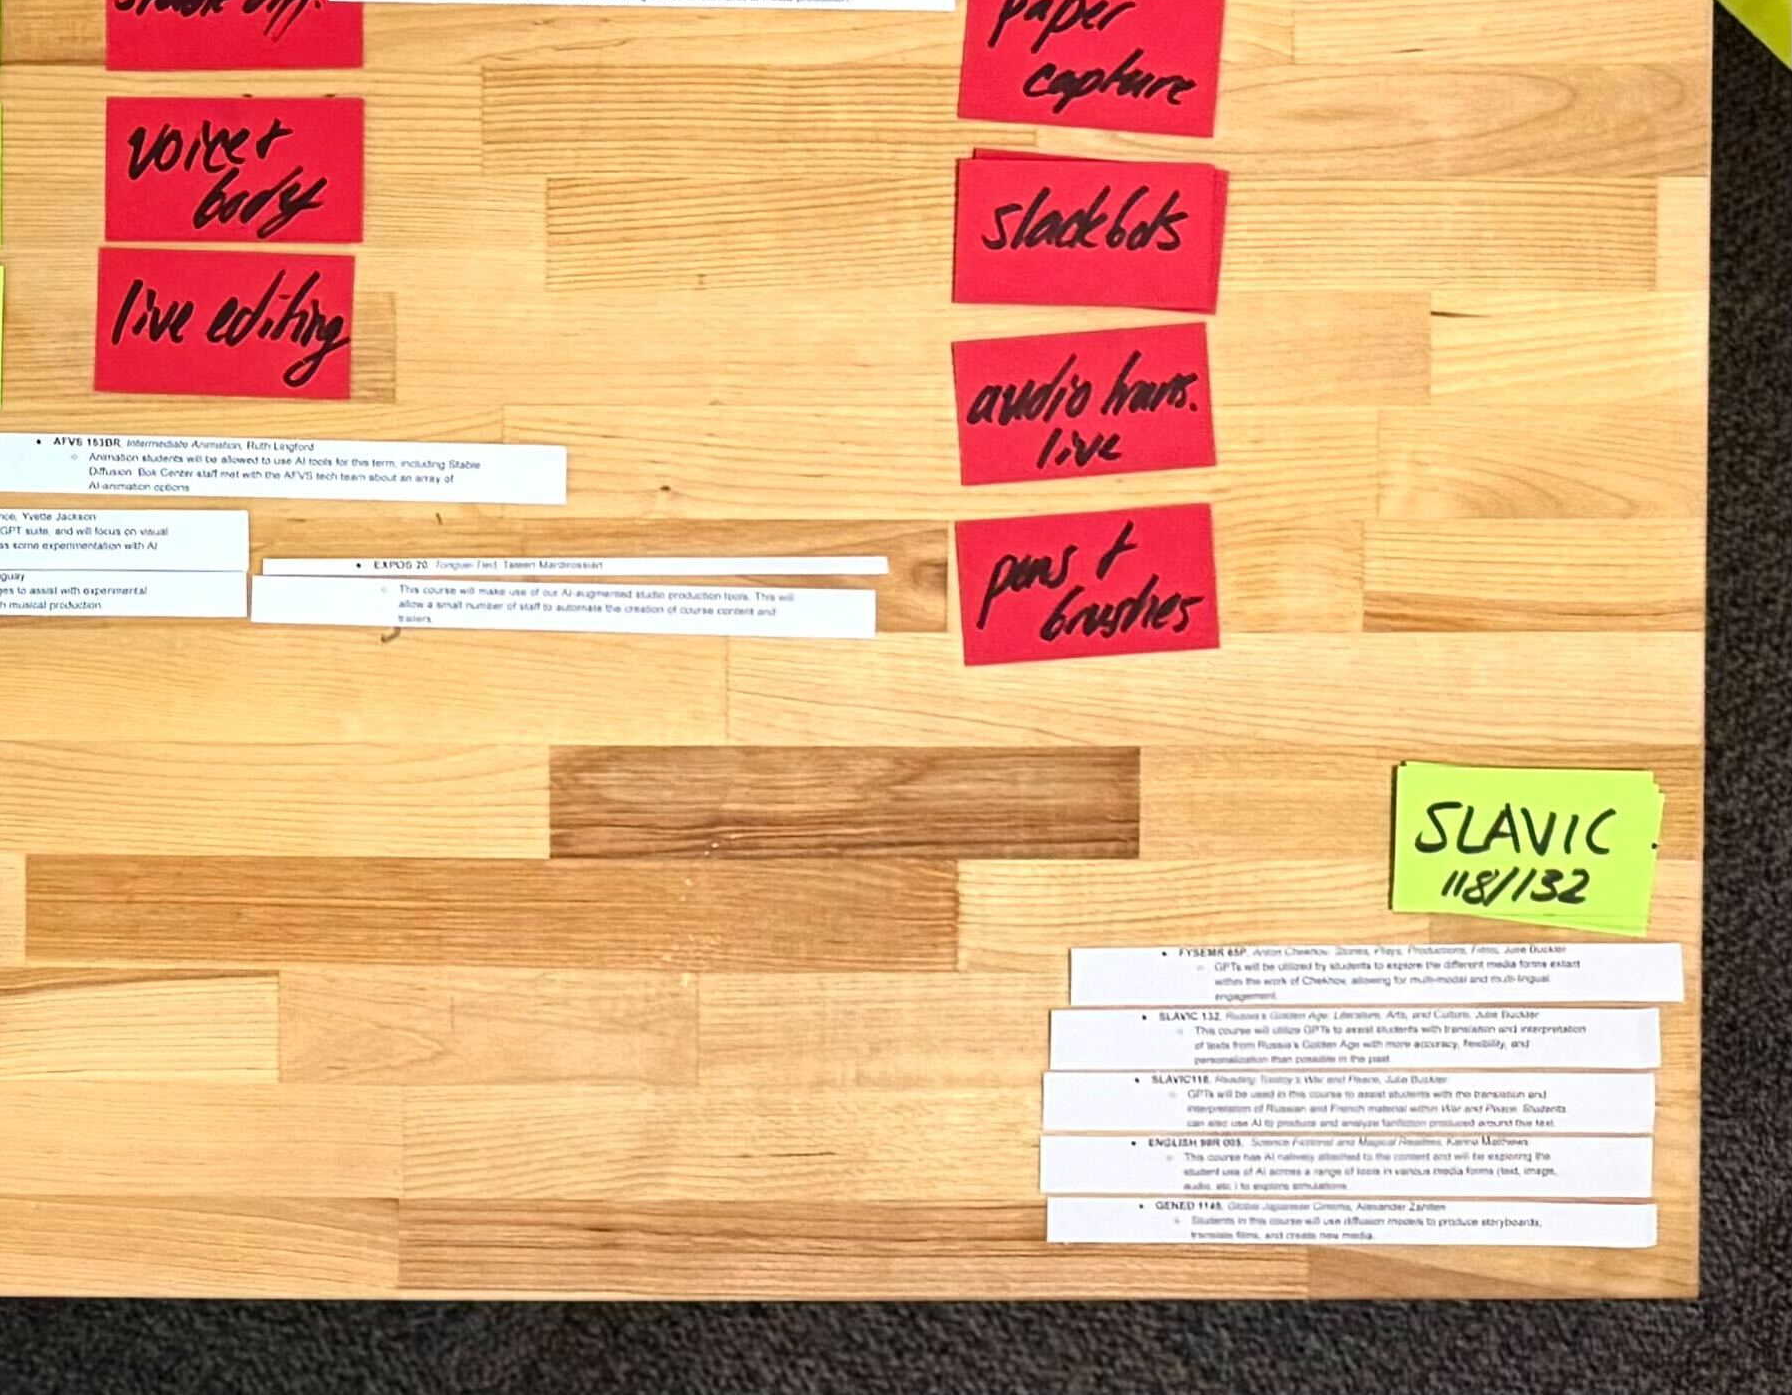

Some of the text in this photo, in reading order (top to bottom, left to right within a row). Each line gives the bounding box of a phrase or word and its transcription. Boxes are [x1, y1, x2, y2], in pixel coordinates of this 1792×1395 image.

[1022, 49, 1196, 113] capture
[193, 167, 327, 239] body
[113, 274, 349, 386] live editing
[1037, 428, 1122, 469] live
[976, 545, 1078, 631] pens
[1039, 573, 1204, 642] brushes
[1415, 802, 1615, 855] SLAVIC
